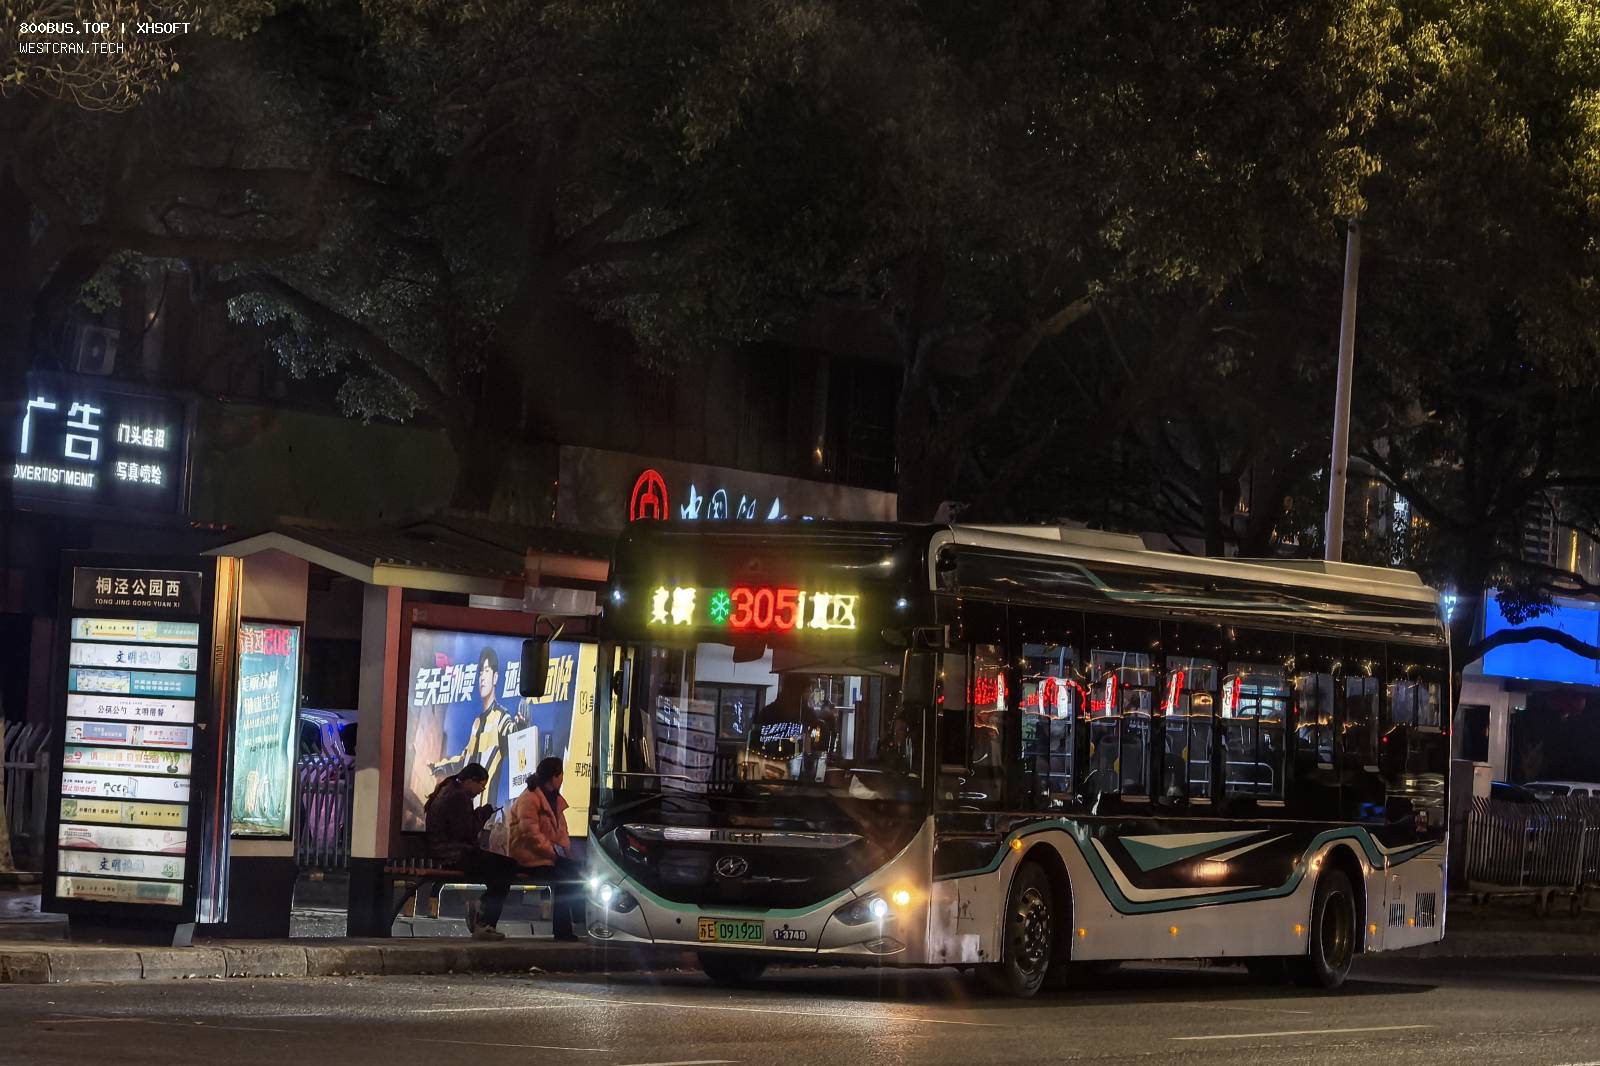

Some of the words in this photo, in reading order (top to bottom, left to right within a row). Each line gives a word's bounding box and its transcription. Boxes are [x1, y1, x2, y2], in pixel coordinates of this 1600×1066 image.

[20, 396, 101, 461] 广告
[117, 423, 166, 448] 门头店招
[116, 461, 162, 485] 写真喷绘
[95, 576, 181, 597] 桐泾公园西
[95, 598, 113, 606] TONG
[153, 600, 172, 608] YUAN
[730, 587, 799, 628] 305
[502, 656, 574, 704] 还团快
